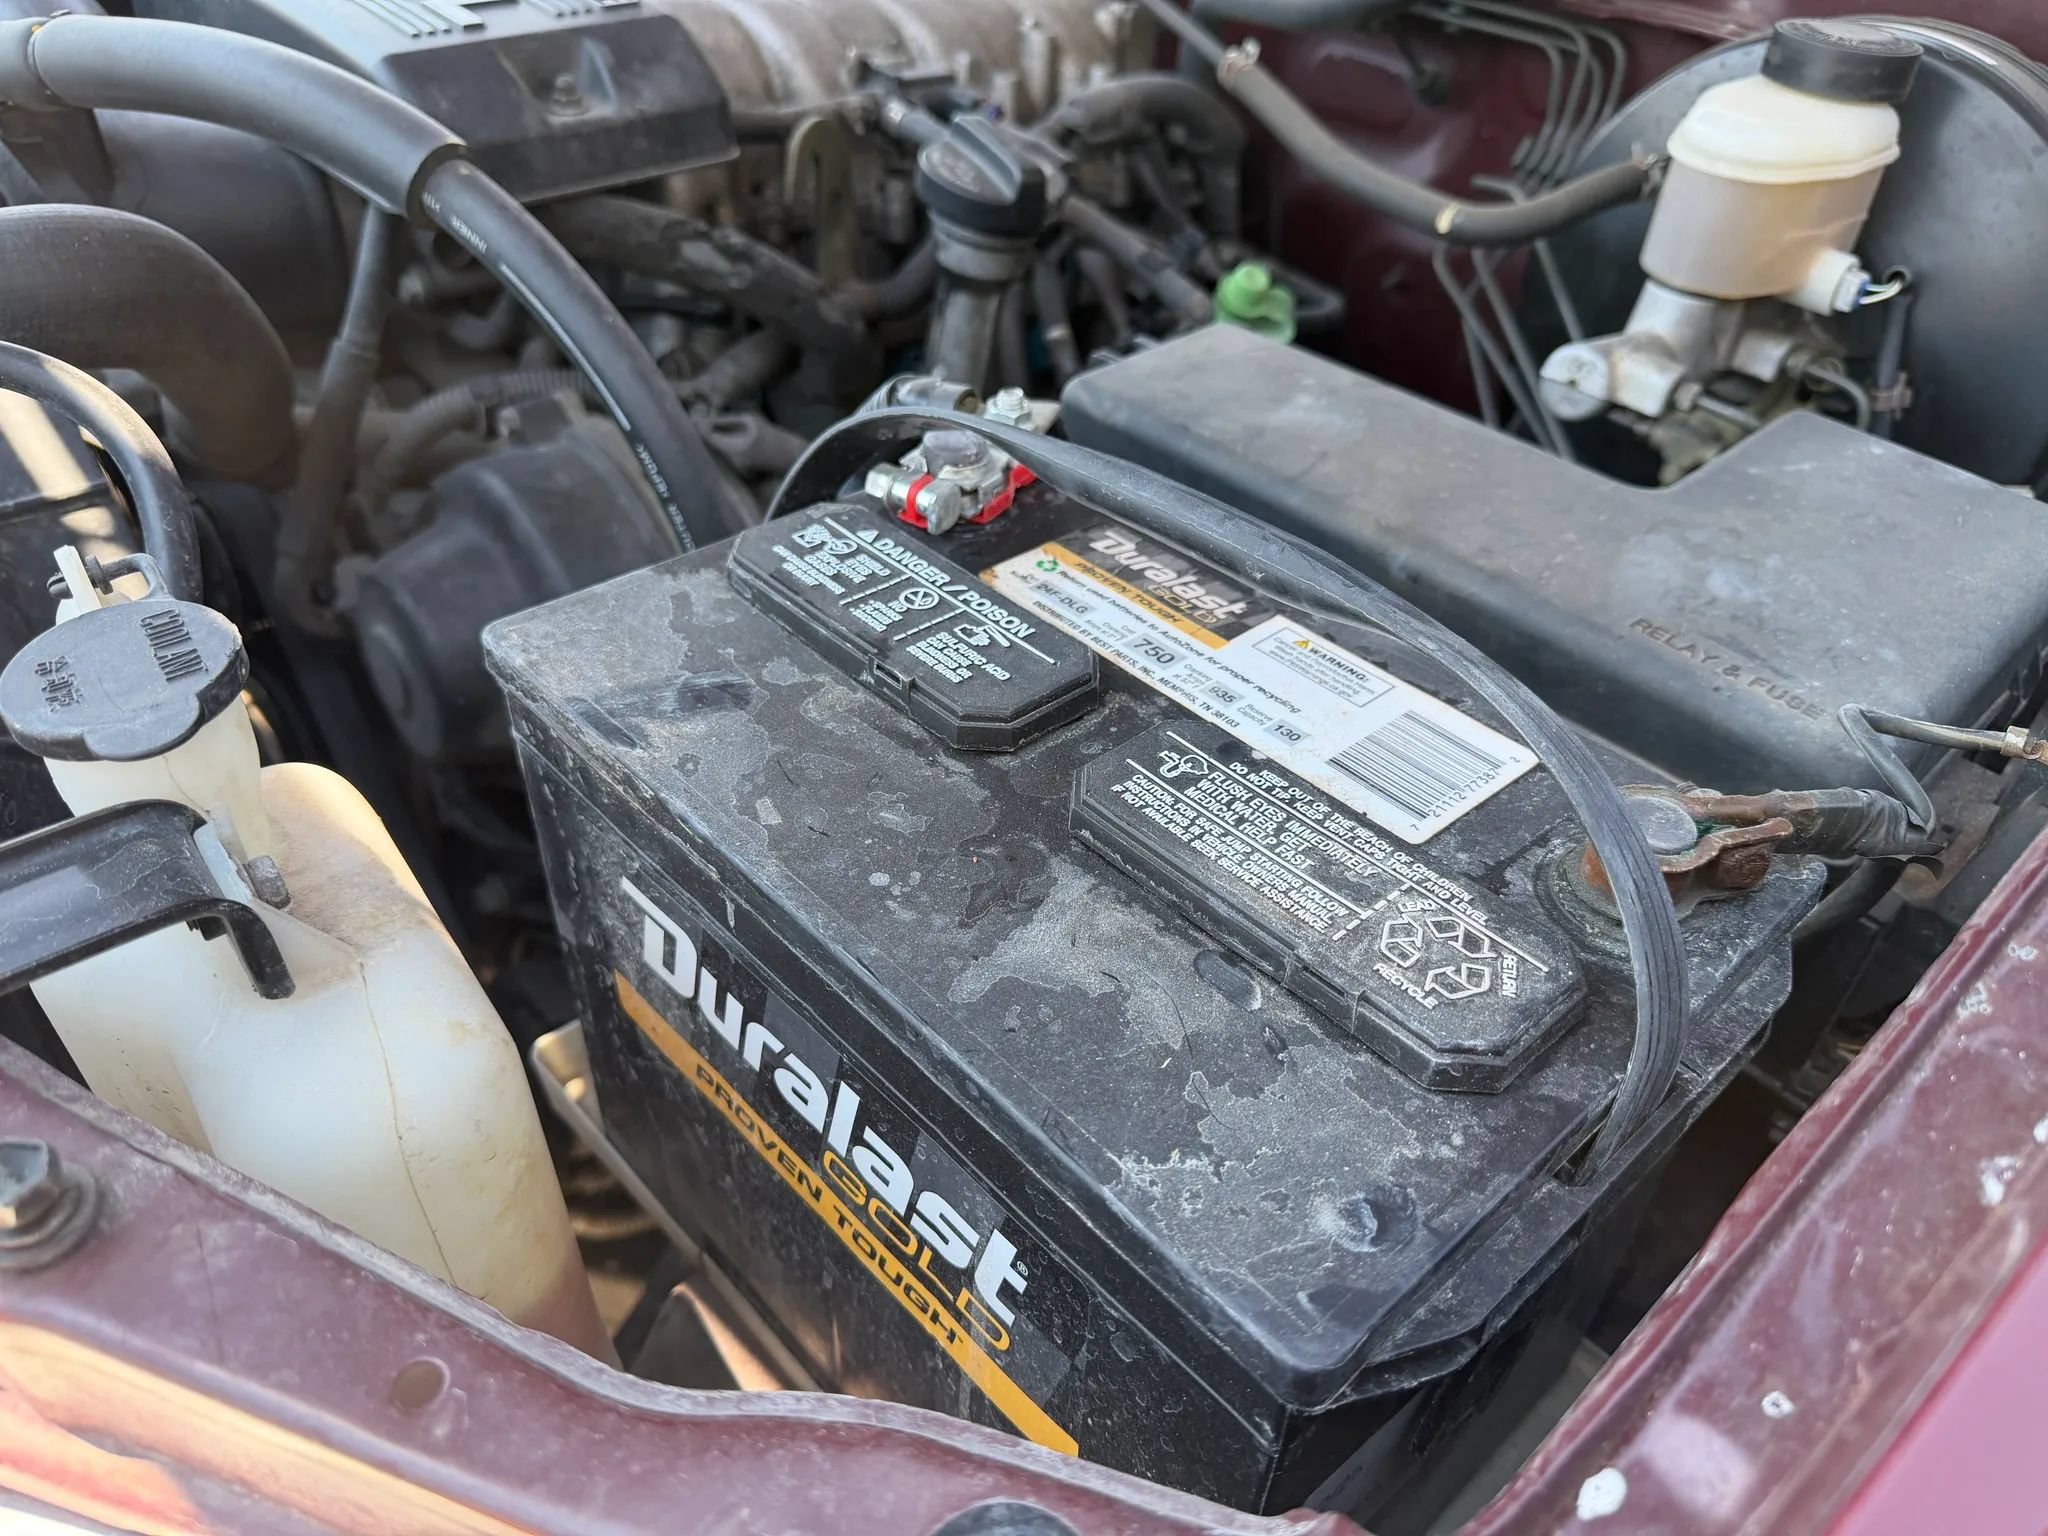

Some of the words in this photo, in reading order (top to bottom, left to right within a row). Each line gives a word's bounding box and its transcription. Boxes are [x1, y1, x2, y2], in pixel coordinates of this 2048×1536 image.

[804, 555, 837, 575] GASES
[815, 551, 866, 583] EXPLOSIVE
[845, 559, 872, 575] EYES
[856, 554, 890, 576] SHIELD
[1089, 531, 1247, 621] Duralast
[888, 600, 907, 612] NO
[959, 591, 1034, 637] POISON
[1036, 584, 1088, 613] 24F-DLG
[1075, 562, 1132, 594] PROVEN
[1133, 594, 1183, 626] TOUGH
[1147, 583, 1219, 625] GOLD
[140, 607, 209, 683] COOLANT
[906, 645, 938, 666] SEVERE
[933, 664, 962, 682] BURNS
[916, 641, 958, 668] BLINDNESS
[956, 668, 972, 678] OR
[926, 637, 946, 649] CAN
[943, 648, 972, 666] CAUSE
[936, 632, 986, 664] SULFURIC
[981, 663, 1010, 680] ACID
[1033, 601, 1080, 629] DISTRIBUTED
[1079, 629, 1093, 637] BY
[1090, 636, 1112, 650] BEST
[1199, 702, 1213, 711] TN
[1211, 711, 1240, 727] 38103
[1087, 588, 1110, 600] used
[1108, 600, 1147, 623] batteries
[1159, 631, 1204, 656] AutoZone
[1204, 657, 1221, 665] for
[1218, 666, 1254, 684] proper
[1253, 685, 1300, 713] recycling
[1134, 639, 1175, 663] 750
[1310, 648, 1368, 680] WARNING:
[1629, 617, 1721, 664] RELAY
[1722, 663, 1743, 680] &
[1209, 687, 1236, 702] 935
[1237, 707, 1265, 726] Capacity
[1245, 704, 1273, 721] Reserve
[1275, 725, 1301, 741] 130
[1197, 779, 1232, 803] WITH
[1280, 832, 1312, 851] GET
[1428, 792, 1467, 817] 21112
[1464, 768, 1499, 792] 77387
[1110, 784, 1125, 792] IF
[1121, 792, 1145, 807] NOT
[1142, 808, 1193, 841] AVAILABLE
[1190, 840, 1221, 860] SEEK
[1218, 857, 1263, 887] SERVICE
[1120, 781, 1190, 826] INSTRUCTIONS
[1188, 825, 1204, 836] IN
[1202, 834, 1245, 863] VEHICLE
[1184, 787, 1238, 824] MEDICAL
[1239, 822, 1277, 845] HELP
[1275, 845, 1313, 869] FAST
[1208, 772, 1252, 800] FLUSH
[1249, 798, 1286, 822] EYES
[1286, 822, 1376, 876] IMMEDIATELY
[1229, 762, 1247, 774] DO
[1246, 773, 1270, 789] NOT
[1293, 801, 1323, 819] KEEP
[1324, 820, 1353, 840] VENT
[1354, 838, 1385, 859] CAPS
[1386, 858, 1422, 881] TIGHT
[1422, 879, 1450, 899] AND
[1450, 898, 1487, 925] LEVEL
[1259, 770, 1288, 787] KEEP
[1288, 787, 1312, 802] OUT
[1312, 802, 1330, 814] OF
[1330, 813, 1356, 829] THE
[1354, 825, 1392, 852] REACH
[1393, 852, 1413, 865] OF
[1412, 863, 1471, 901] CHILDREN
[1174, 803, 1197, 819] FOR
[1195, 817, 1224, 836] SAFE
[1221, 836, 1251, 854] JUMP
[1250, 853, 1303, 887] STARTING
[1301, 886, 1348, 916] FOLLOW
[1398, 899, 1438, 911] LEAD
[1374, 963, 1437, 1008] RECYCLE
[1502, 954, 1515, 996] RETURN
[694, 1065, 825, 1207] PROVEN
[832, 1206, 962, 1346] TOUGH
[823, 1147, 1011, 1352] GOLD
